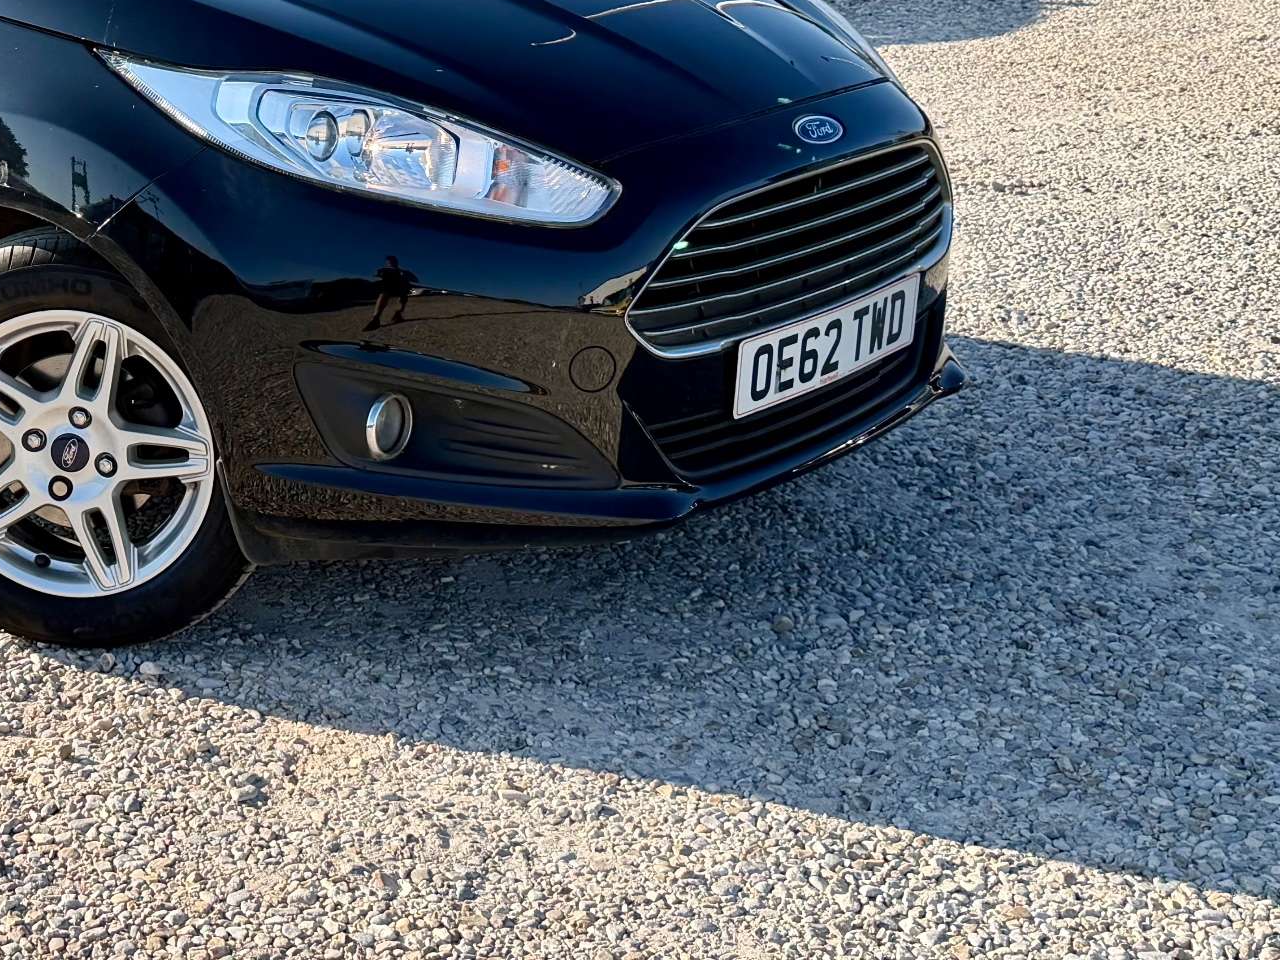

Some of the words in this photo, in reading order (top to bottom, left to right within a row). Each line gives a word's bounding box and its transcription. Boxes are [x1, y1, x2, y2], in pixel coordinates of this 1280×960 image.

[804, 120, 834, 139] Ford
[750, 318, 843, 403] OE62
[852, 289, 906, 362] TWD
